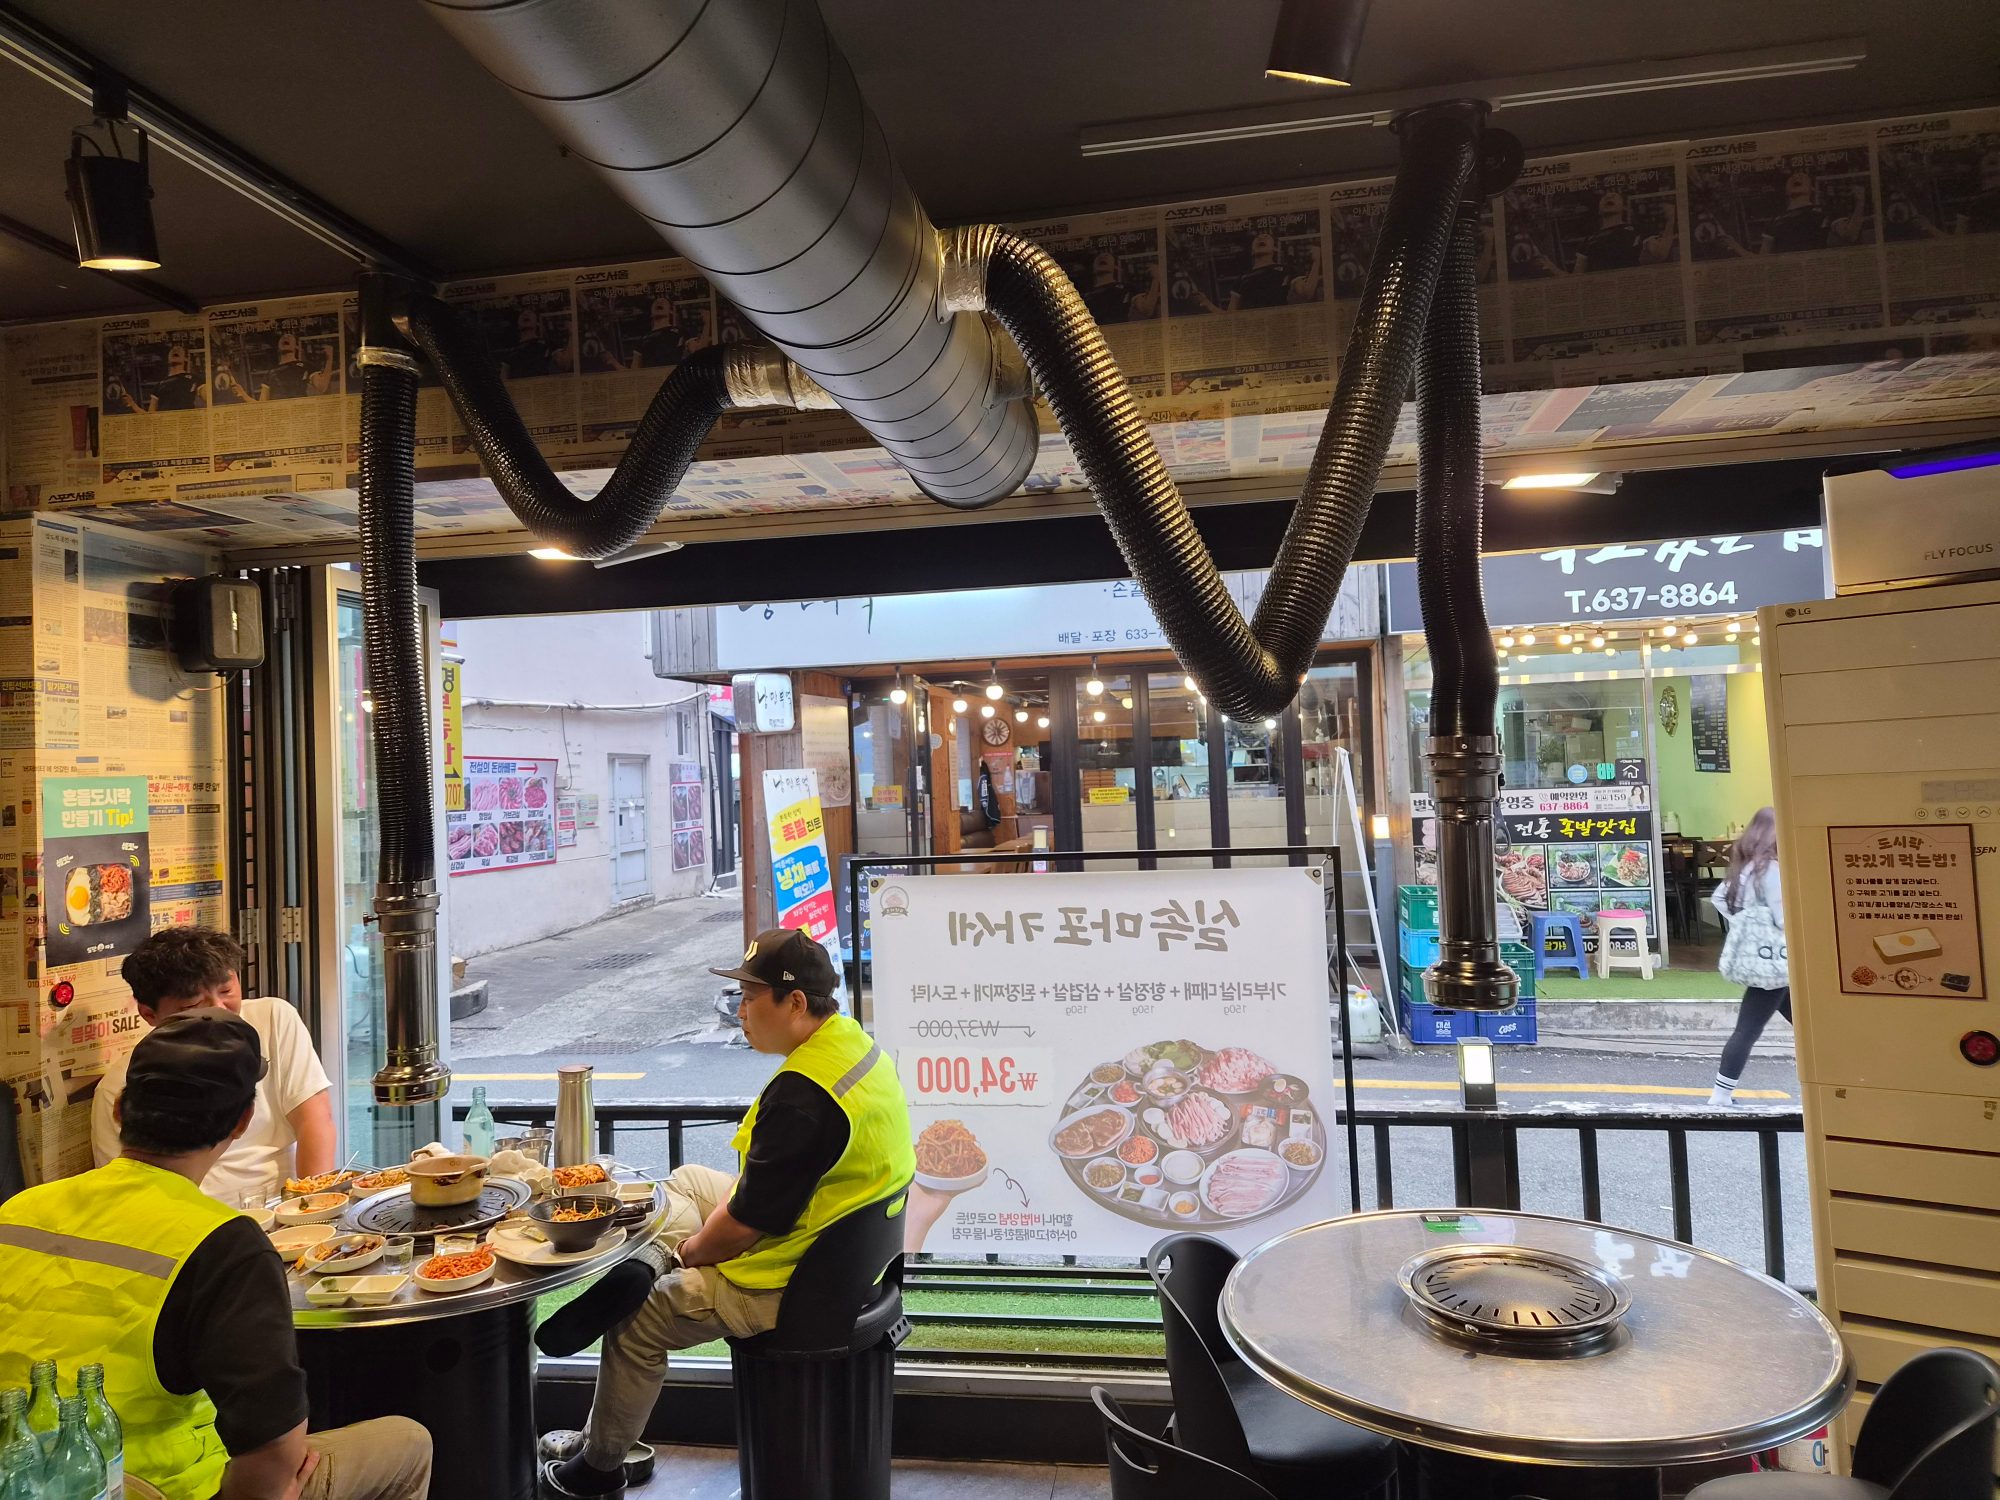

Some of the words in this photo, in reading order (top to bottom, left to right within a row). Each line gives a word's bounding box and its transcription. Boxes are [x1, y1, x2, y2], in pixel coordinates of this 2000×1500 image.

[1686, 141, 1758, 160] 스포츠서울
[1164, 203, 1227, 221] 스포츠서울
[575, 269, 629, 285] 스포츠서울
[208, 307, 258, 321] 스포츠서울
[1923, 549, 1945, 561] FLY
[1949, 543, 1993, 558] FOCUS
[1564, 580, 1739, 614] T.637-8864
[1798, 607, 1812, 616] LG
[1057, 631, 1082, 645] 배달
[1091, 629, 1117, 643] 포장
[469, 762, 490, 774] 전설의
[62, 787, 132, 807] 흔들도시락
[1549, 791, 1588, 801] 예약환영
[1539, 801, 1589, 812] 637-8864
[61, 809, 104, 829] 만들기
[105, 808, 134, 828] Tip!
[1558, 817, 1637, 837] 족발맛집
[1877, 834, 1925, 851] 도시락
[1844, 853, 1895, 869] 맛있게
[1898, 852, 1957, 868] 먹는법!
[1879, 889, 1901, 897] 고기를
[112, 1014, 140, 1034] SALE
